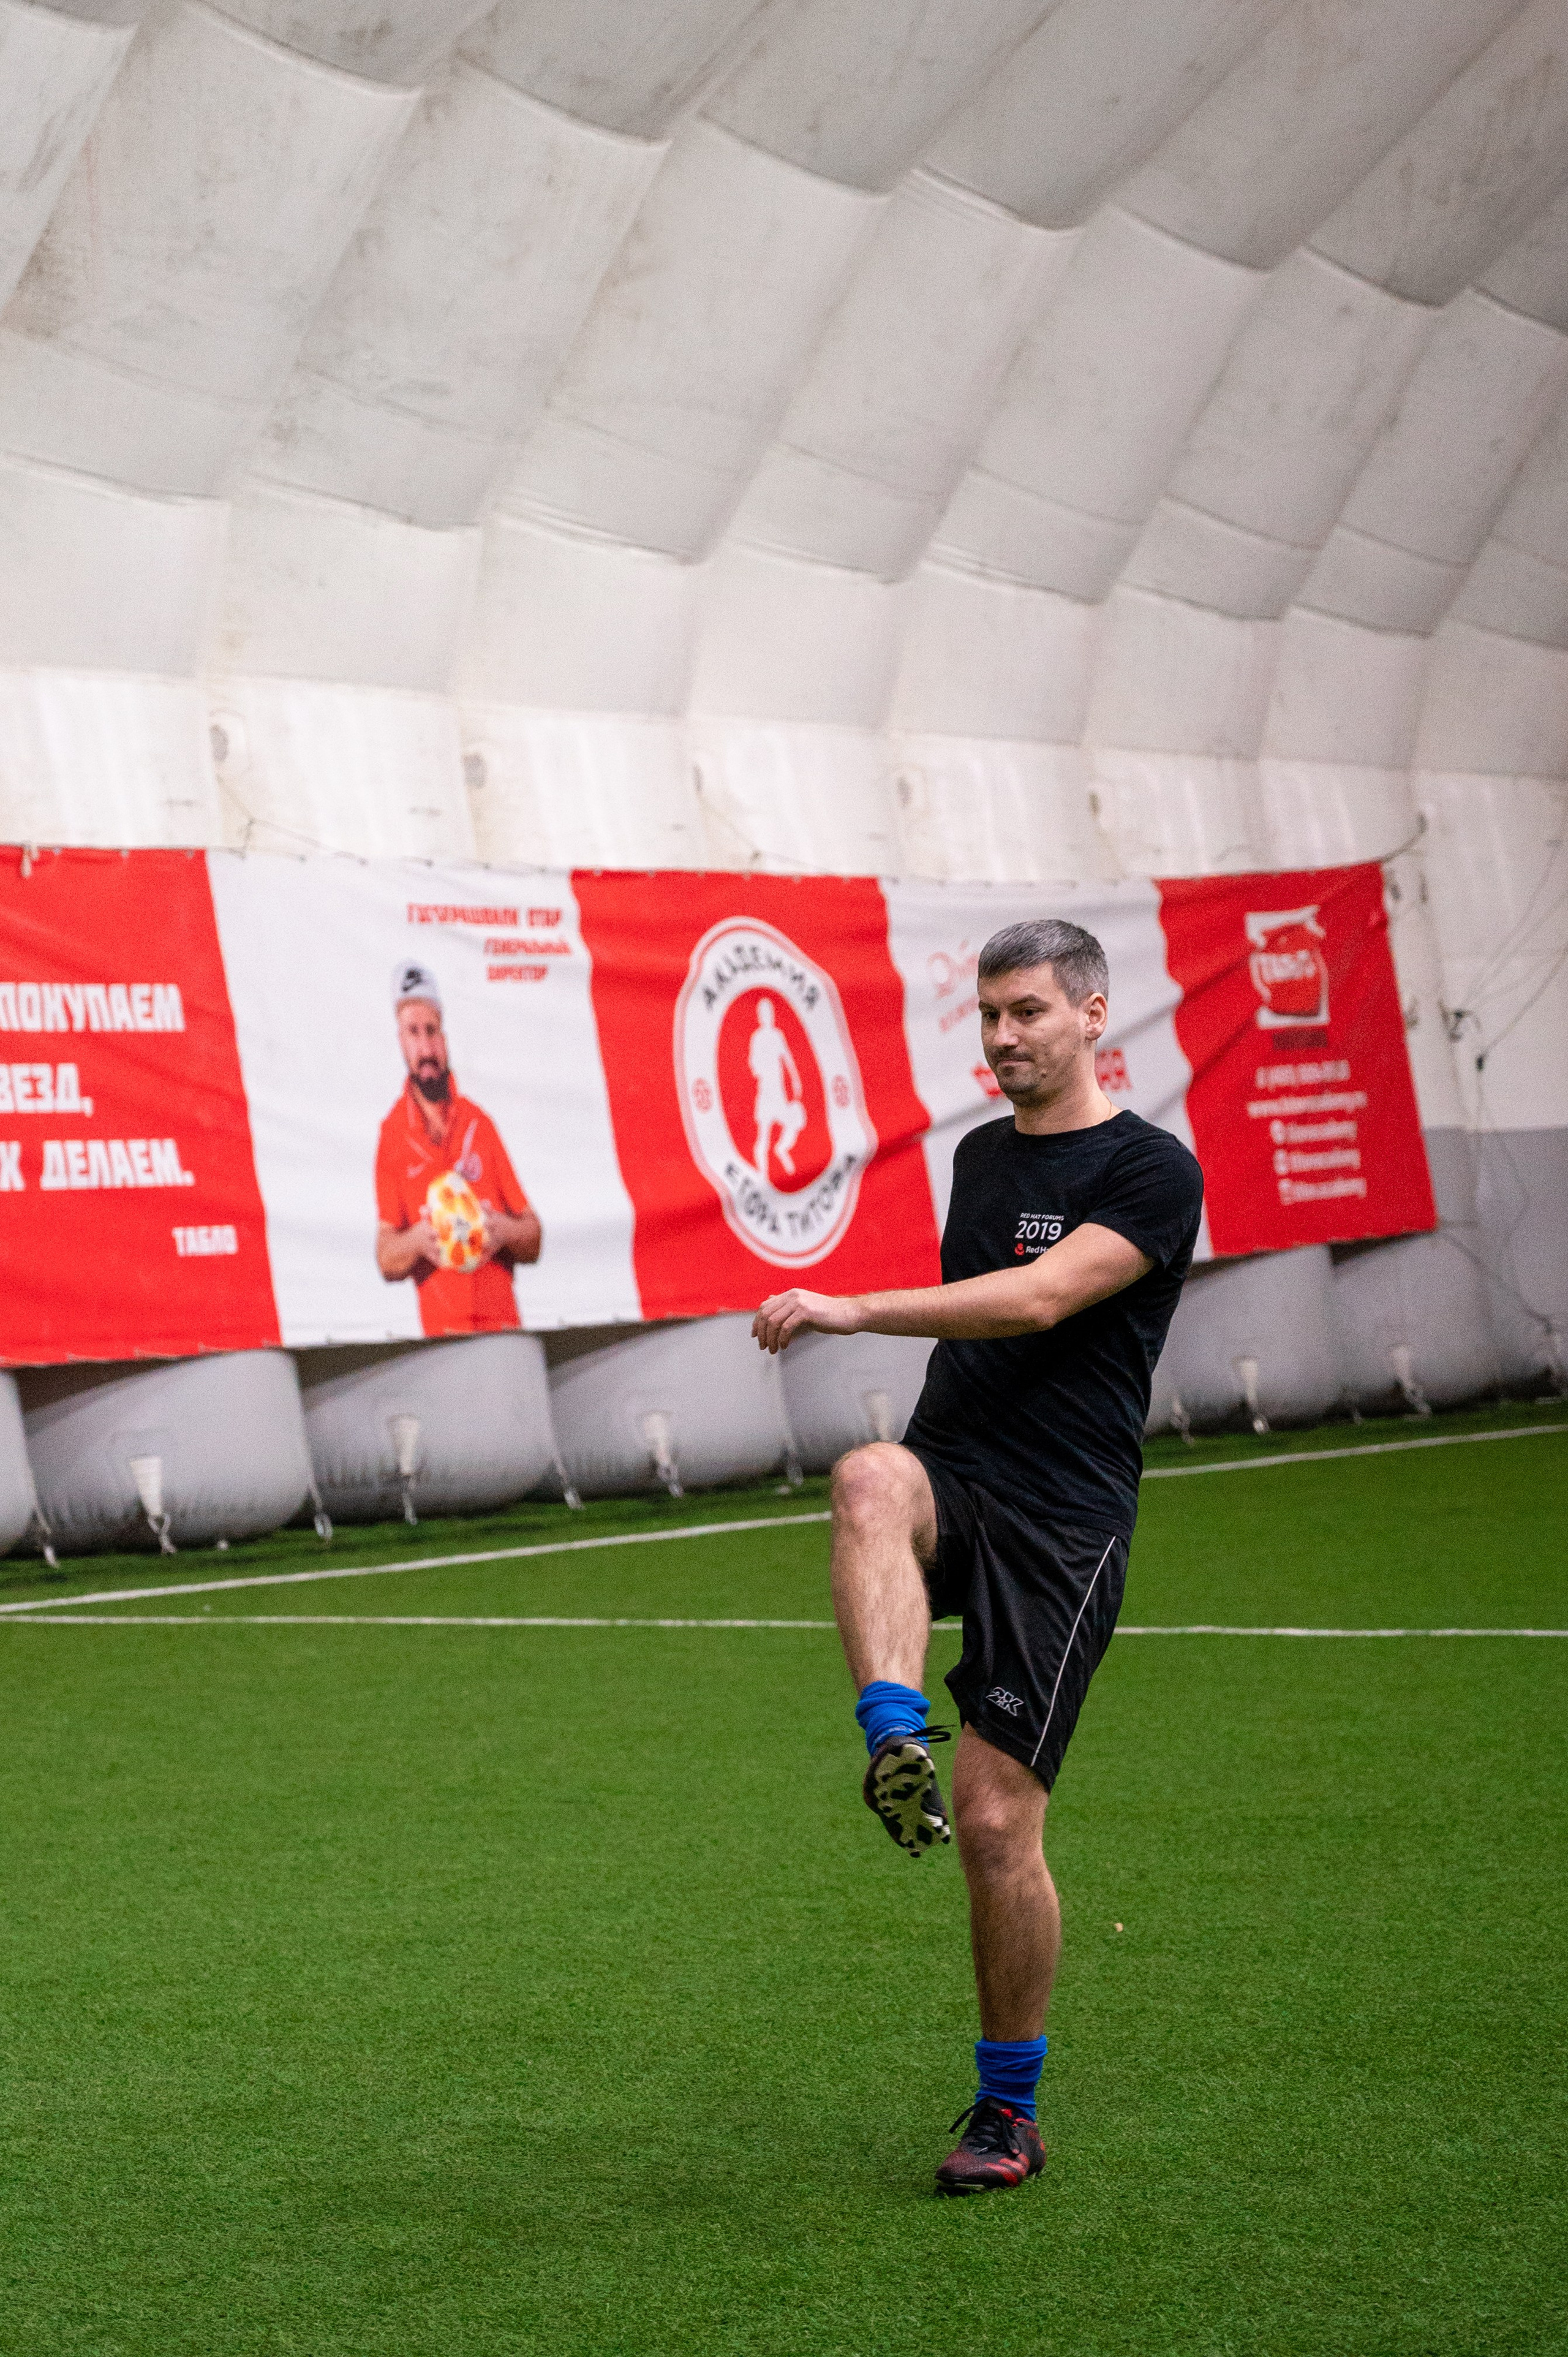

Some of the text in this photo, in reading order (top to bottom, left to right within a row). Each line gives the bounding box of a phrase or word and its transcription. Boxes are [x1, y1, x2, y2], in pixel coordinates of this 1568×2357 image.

[0, 982, 185, 1032] ПОКУПАЕМ
[40, 1138, 194, 1190] ДЕЛАЕМ.
[1015, 1220, 1062, 1240] 2019
